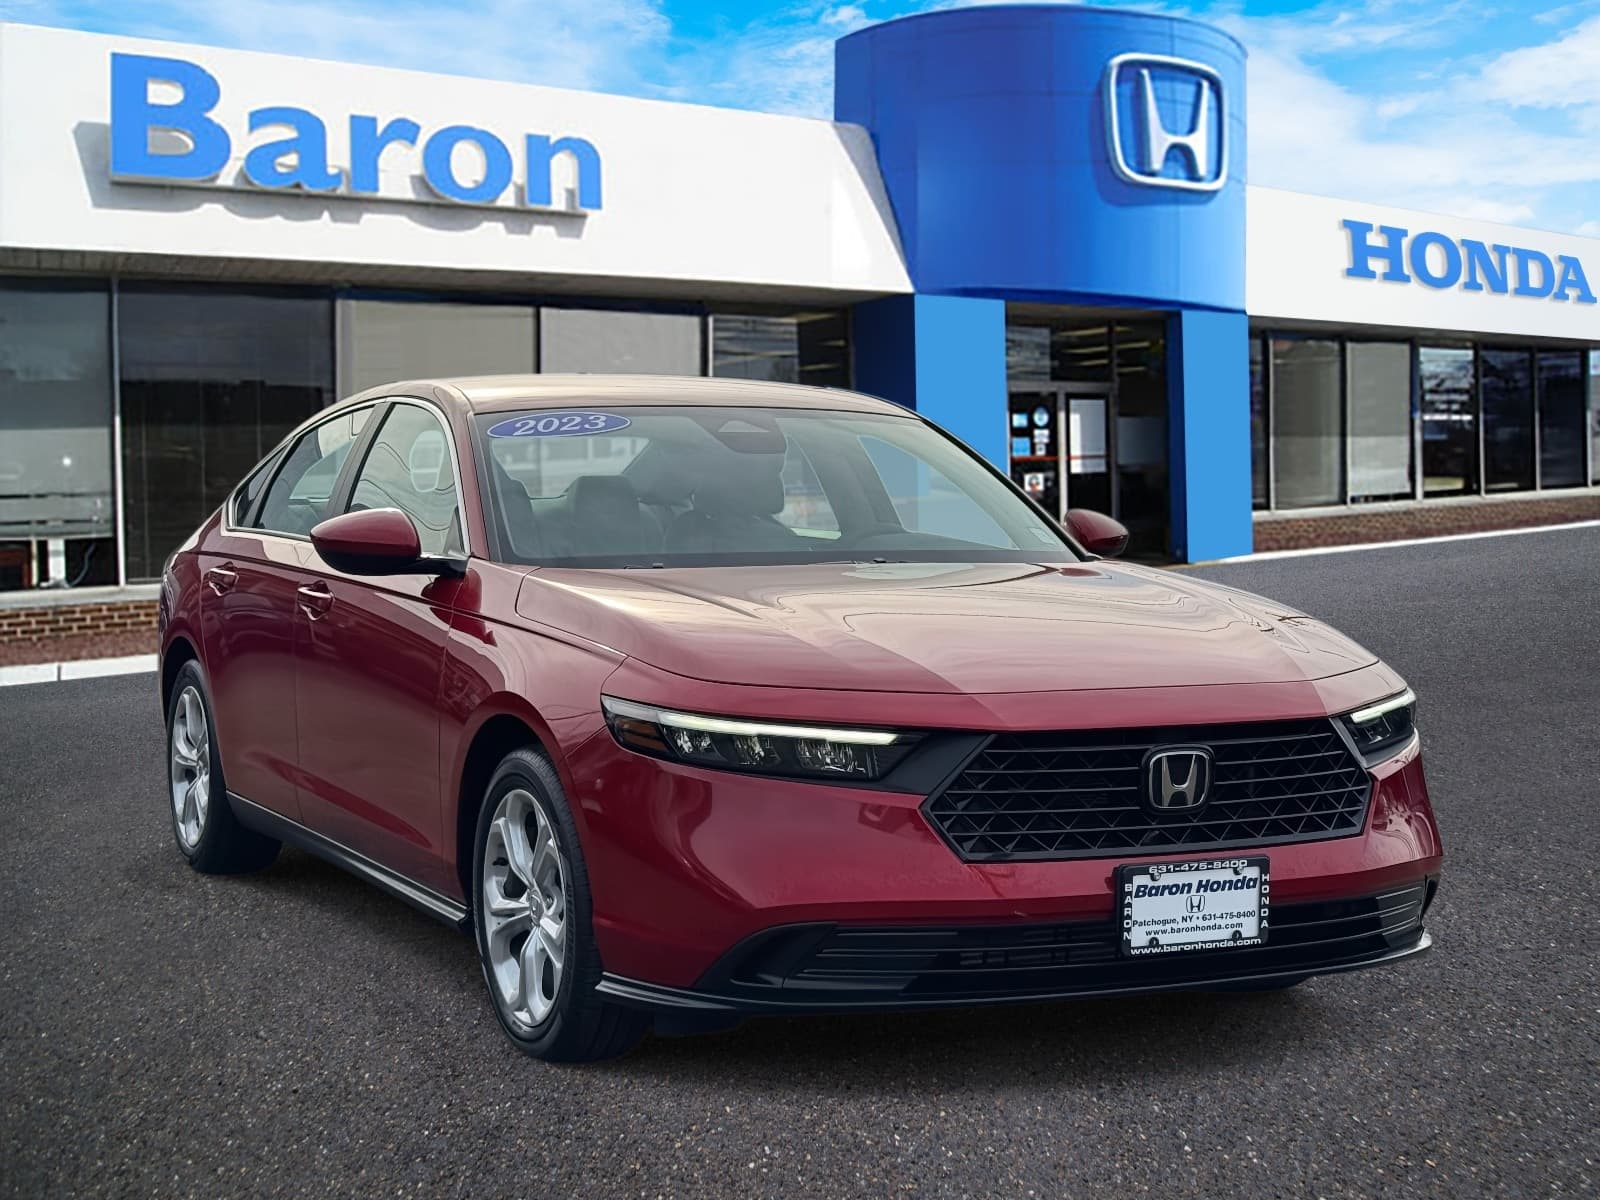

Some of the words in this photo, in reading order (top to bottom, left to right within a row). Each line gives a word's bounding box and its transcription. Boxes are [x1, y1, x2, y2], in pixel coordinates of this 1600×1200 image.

[110, 52, 603, 211] Baron
[1342, 218, 1597, 303] HONDA
[512, 415, 607, 436] 2023
[1148, 859, 1248, 873] 631-475-8400
[1133, 882, 1192, 898] Baron
[1195, 876, 1258, 894] Honda
[1260, 873, 1270, 929] HONDA
[1132, 917, 1180, 928] Patchogue,
[1181, 915, 1194, 924] NY
[1201, 909, 1257, 922] 631-475-8400
[1144, 922, 1244, 937] www.baronhonda.com
[1130, 938, 1261, 955] www.baronhonda.com
